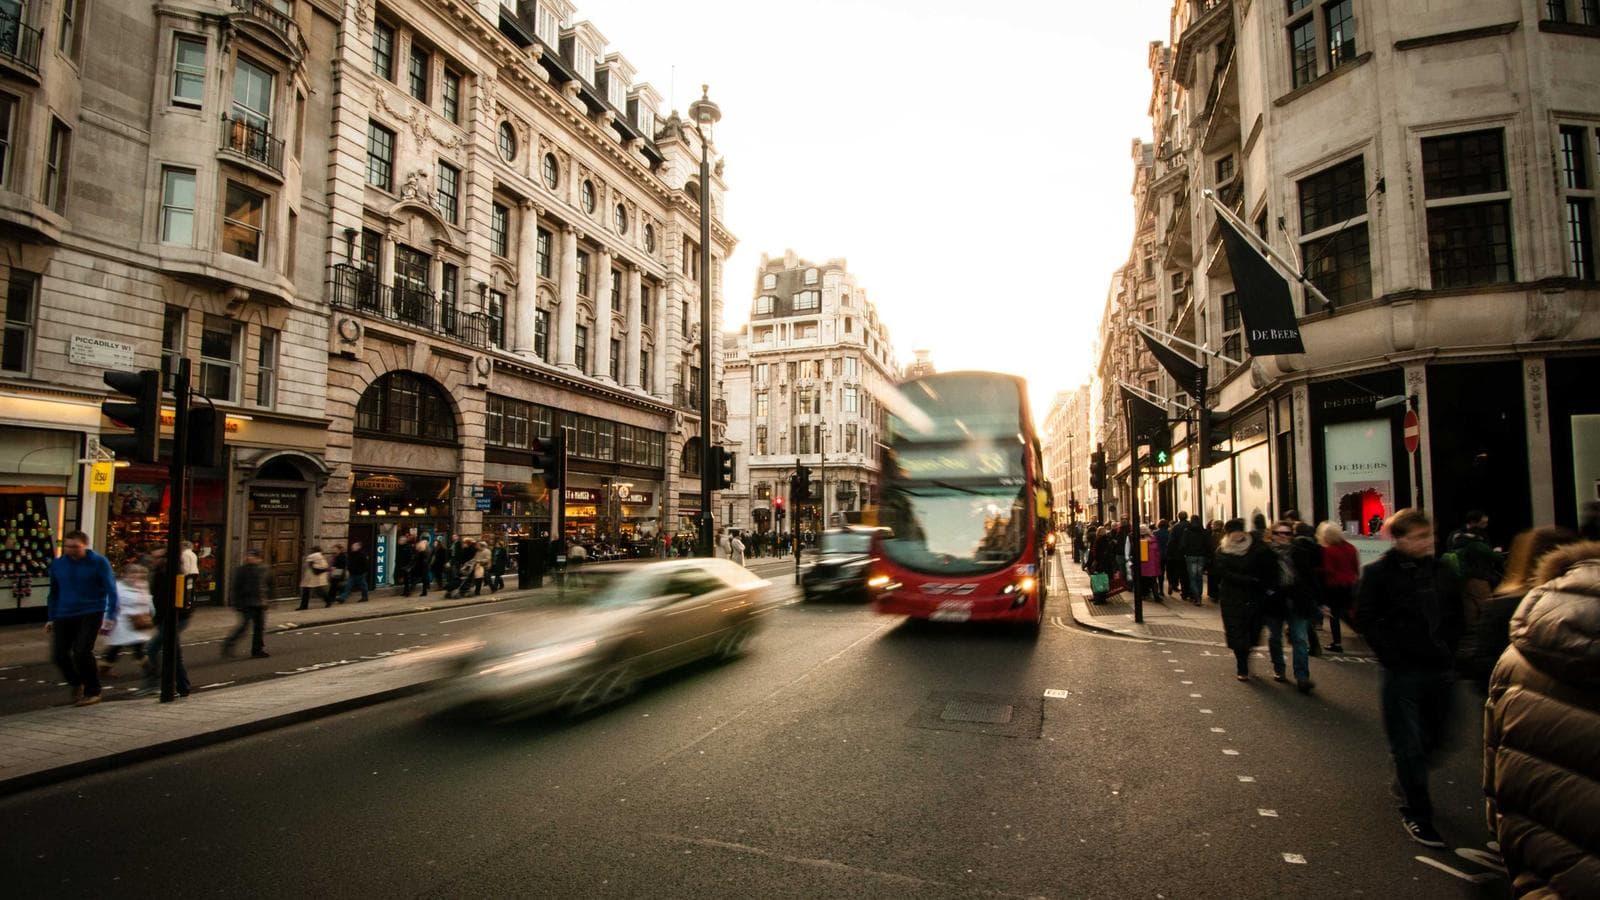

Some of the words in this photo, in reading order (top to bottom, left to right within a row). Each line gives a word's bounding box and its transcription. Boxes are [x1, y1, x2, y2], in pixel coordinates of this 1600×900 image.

[1252, 329, 1269, 341] DE
[1270, 328, 1298, 340] BEERS
[75, 336, 120, 349] PICCADILLY
[121, 344, 132, 352] W1
[1351, 462, 1388, 471] BEERS
[376, 535, 386, 583] MONEY
